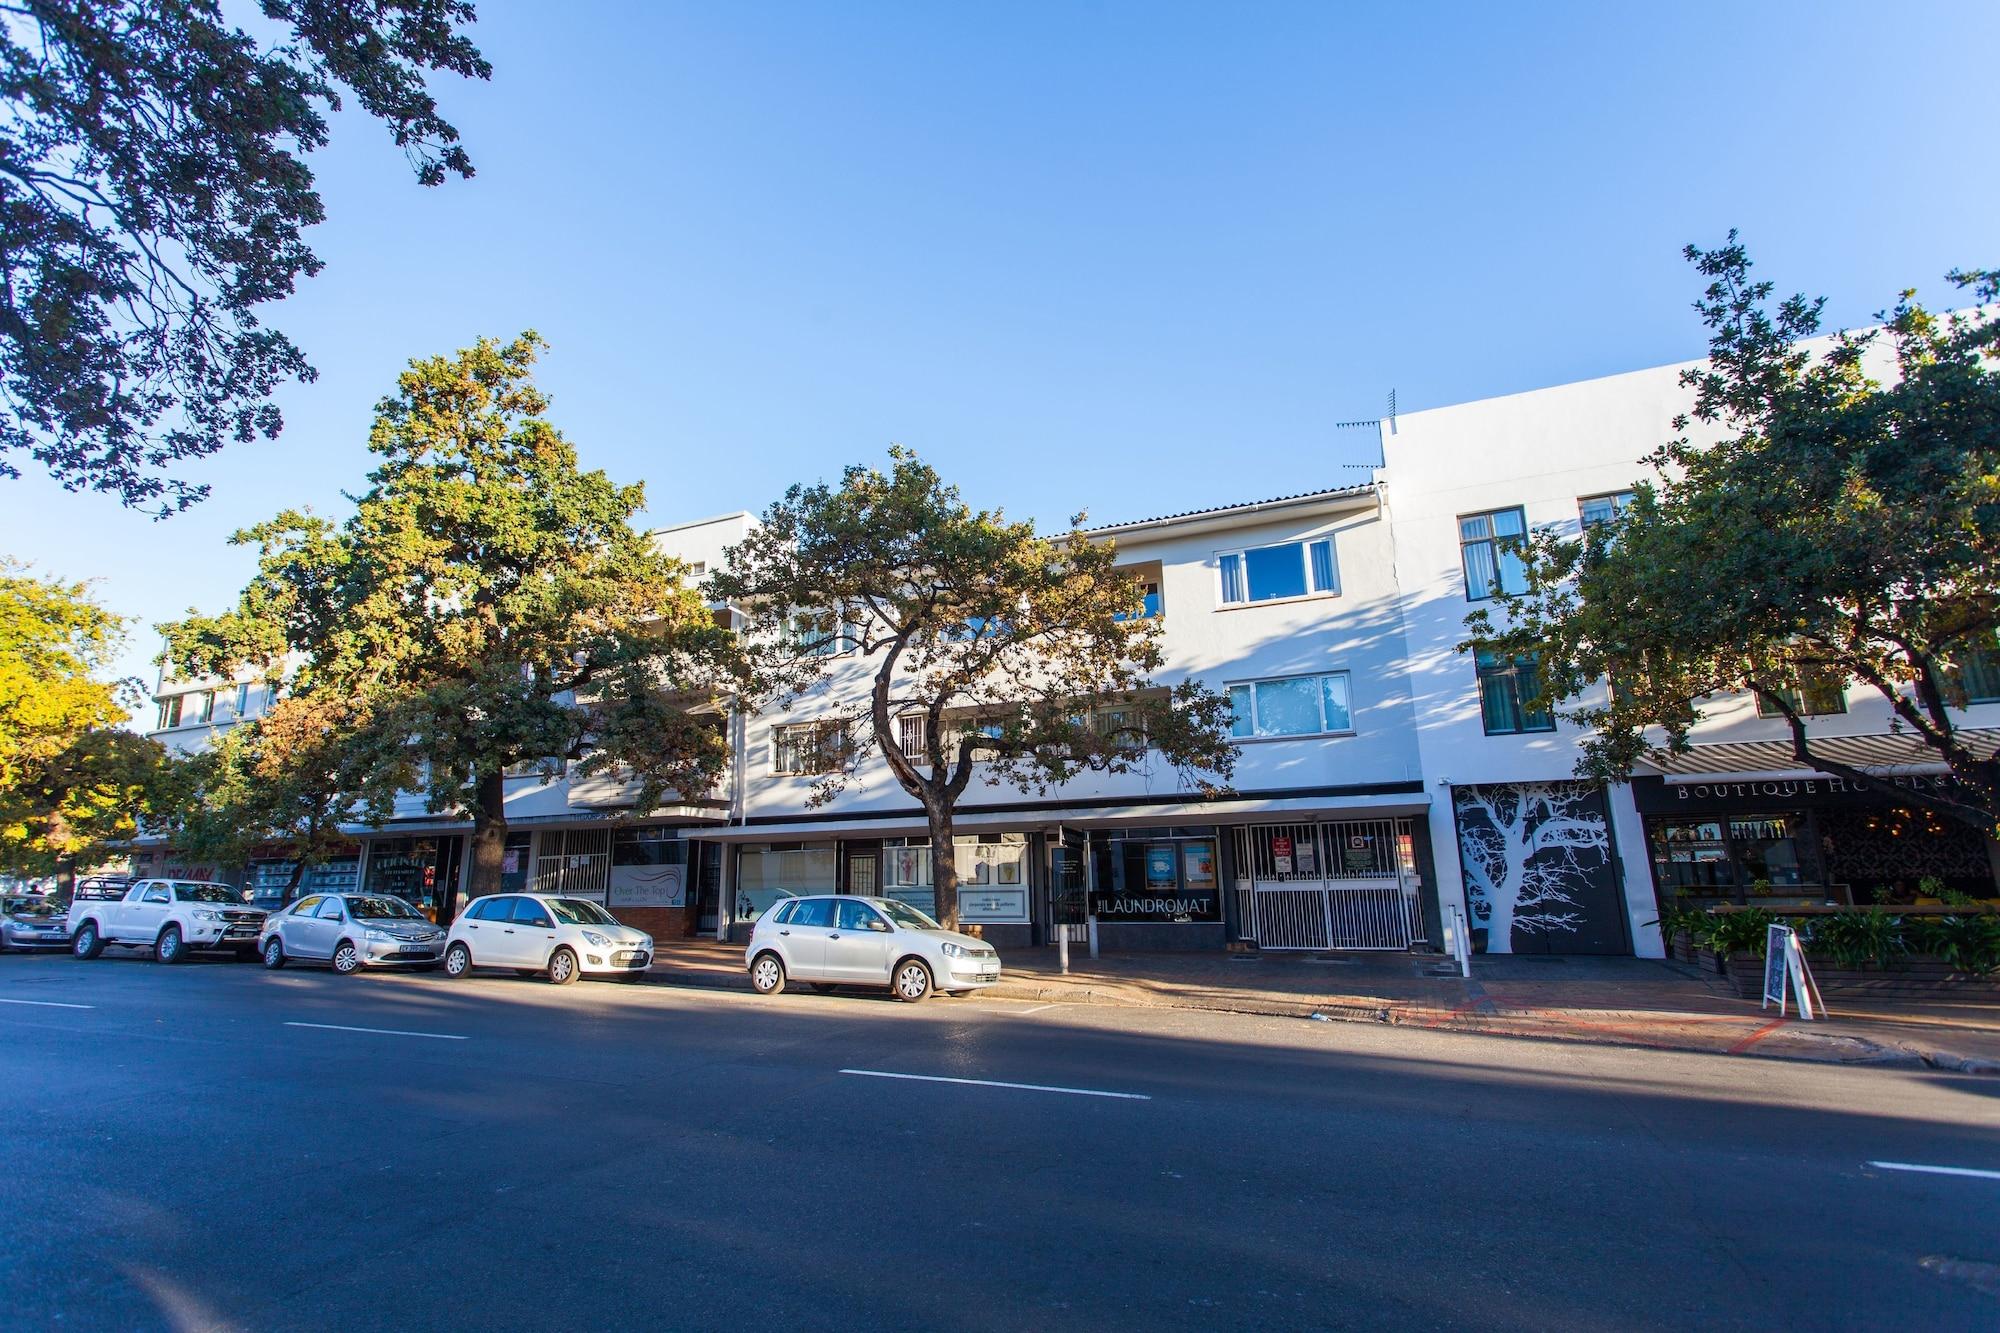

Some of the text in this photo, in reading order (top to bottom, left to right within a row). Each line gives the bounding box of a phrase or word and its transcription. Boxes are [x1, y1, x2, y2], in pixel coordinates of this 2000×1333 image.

[1677, 780, 1817, 800] BOUTIQUE
[1829, 775, 1925, 793] HOEL
[614, 885, 666, 897] Over The Top
[1104, 897, 1211, 914] LAUNDROMAT
